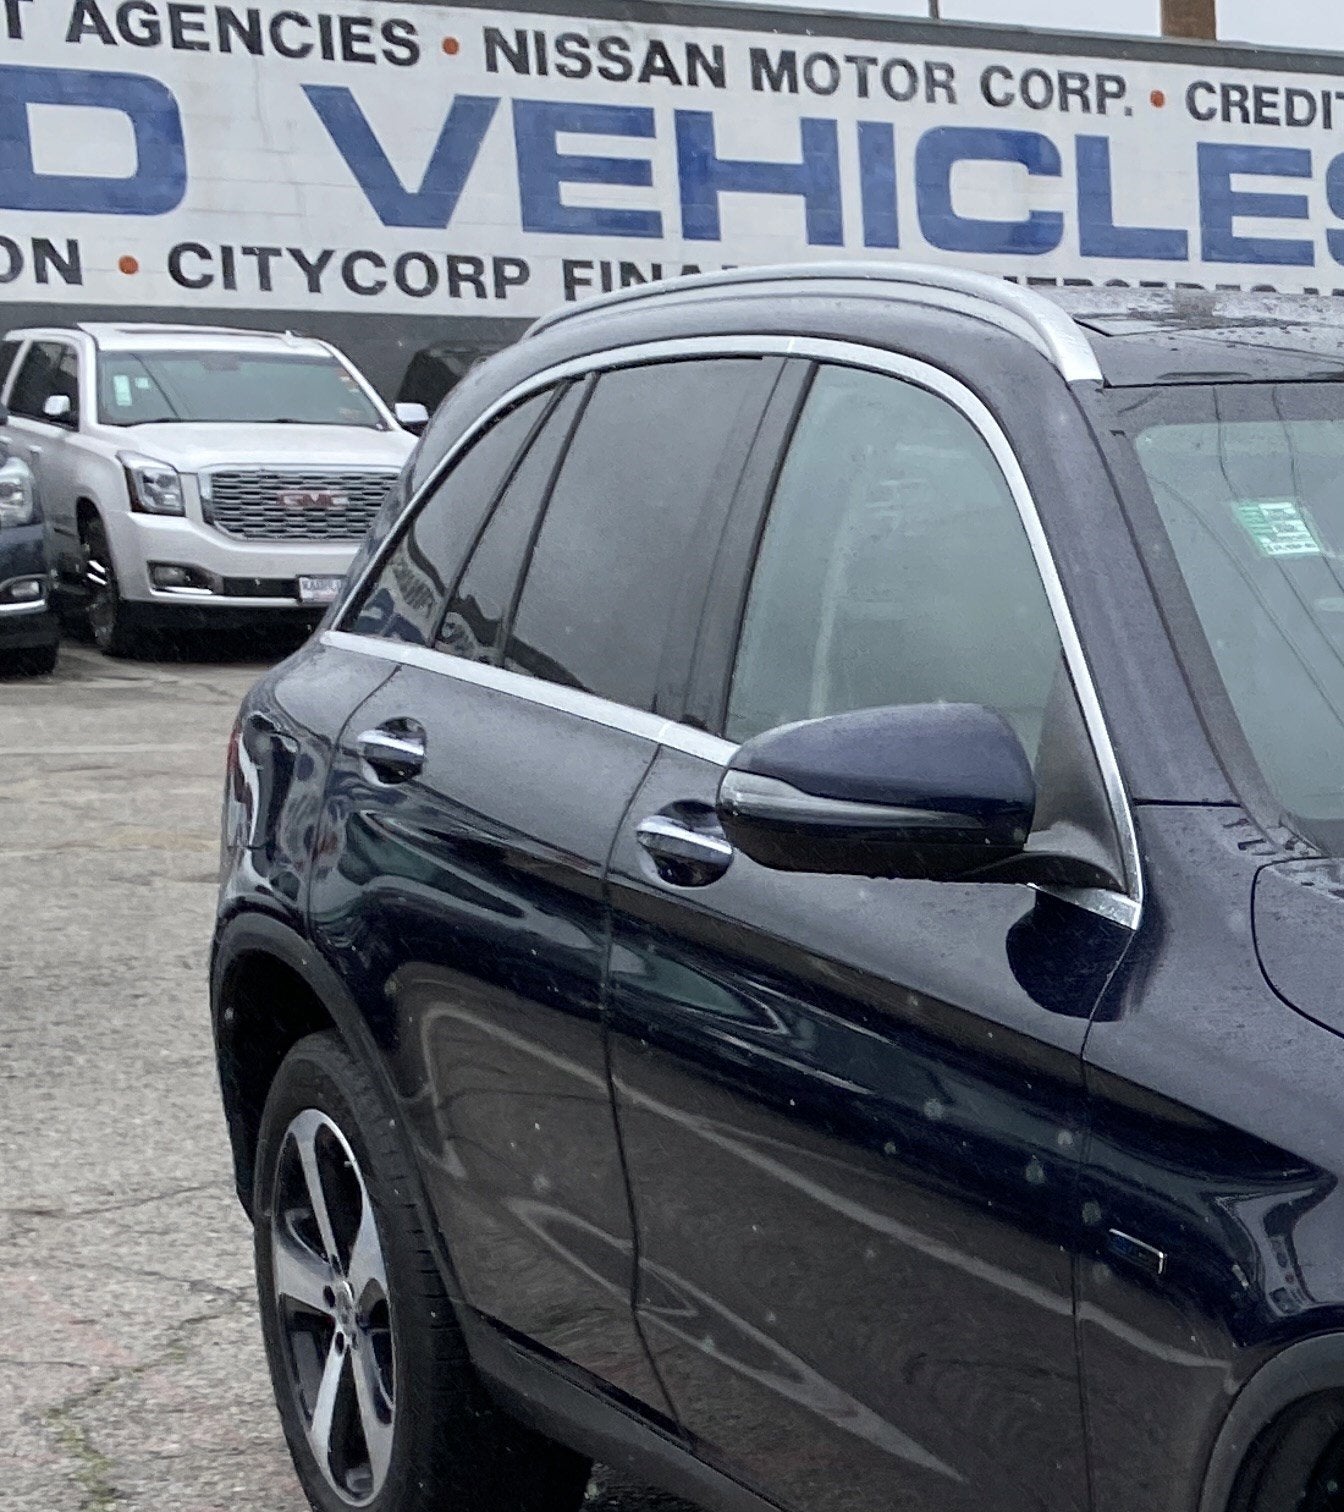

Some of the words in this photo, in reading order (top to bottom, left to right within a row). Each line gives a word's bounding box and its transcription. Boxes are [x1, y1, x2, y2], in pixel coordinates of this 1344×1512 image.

[65, 0, 420, 67] AGENCIES
[483, 27, 727, 89] NISSAN
[749, 47, 957, 104] MOTOR
[980, 66, 1133, 117] CORP.
[167, 242, 530, 300] CITYCORP
